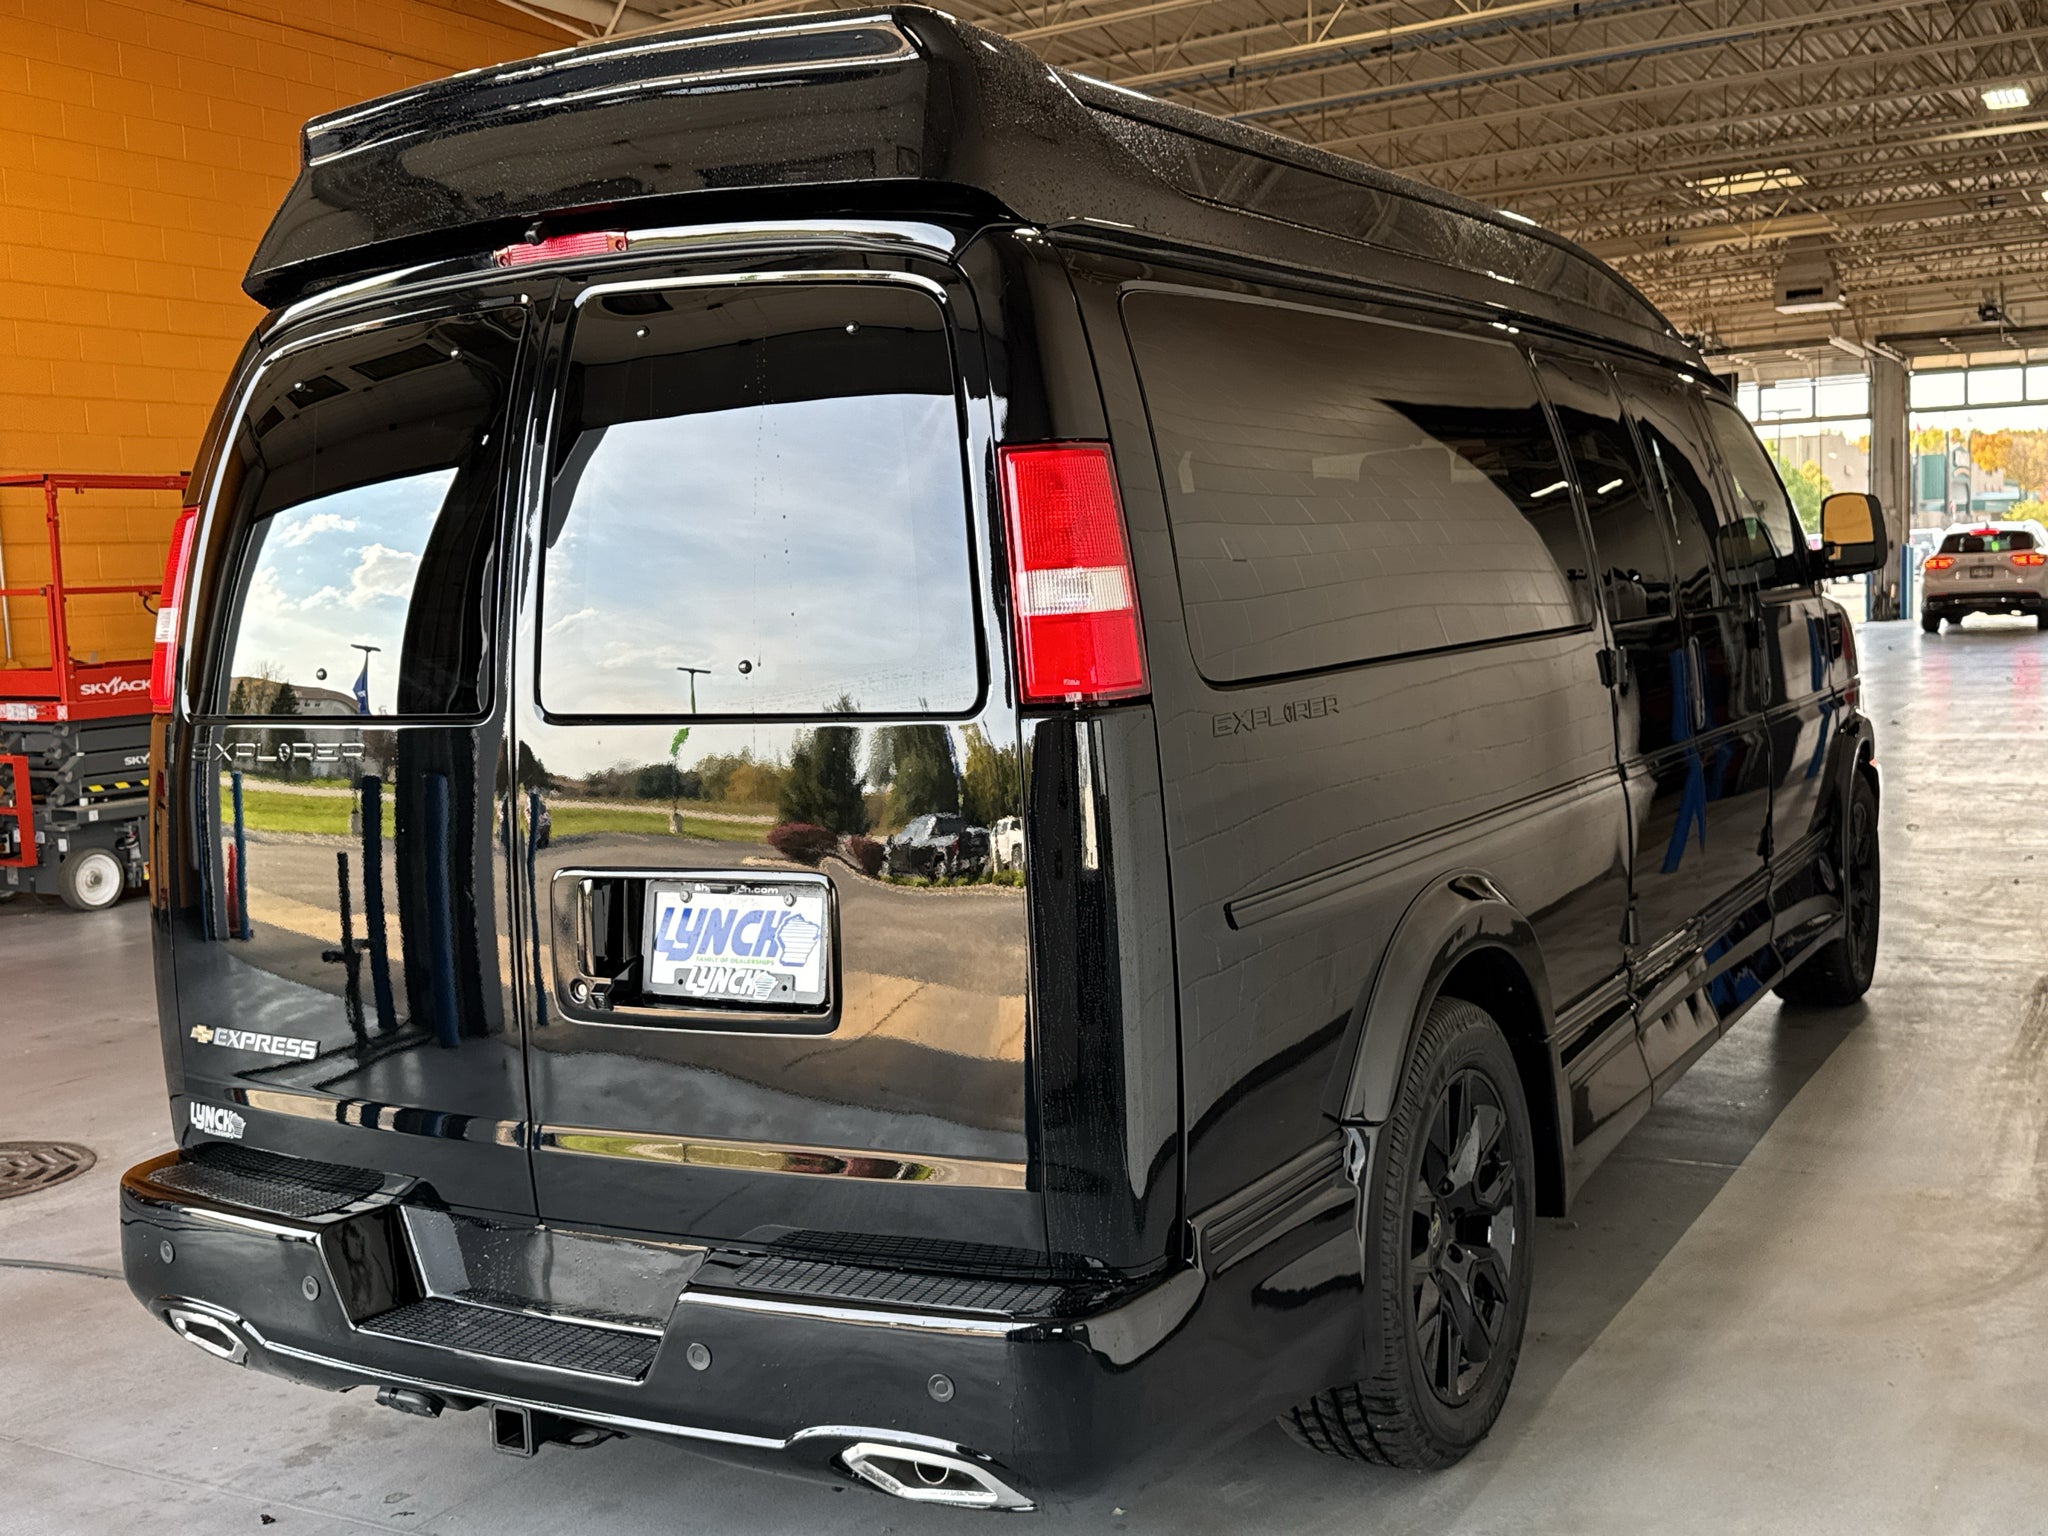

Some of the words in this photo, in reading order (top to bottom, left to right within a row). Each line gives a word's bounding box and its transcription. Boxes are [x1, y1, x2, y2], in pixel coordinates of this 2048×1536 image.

[80, 676, 151, 695] SKYJACK
[1212, 695, 1340, 737] EXPLORER
[192, 742, 366, 762] EXPLORER
[654, 907, 791, 961] LYNCH
[684, 965, 757, 997] LYNCH
[213, 1027, 319, 1060] EXPRESS
[190, 1101, 234, 1134] LYNCH
